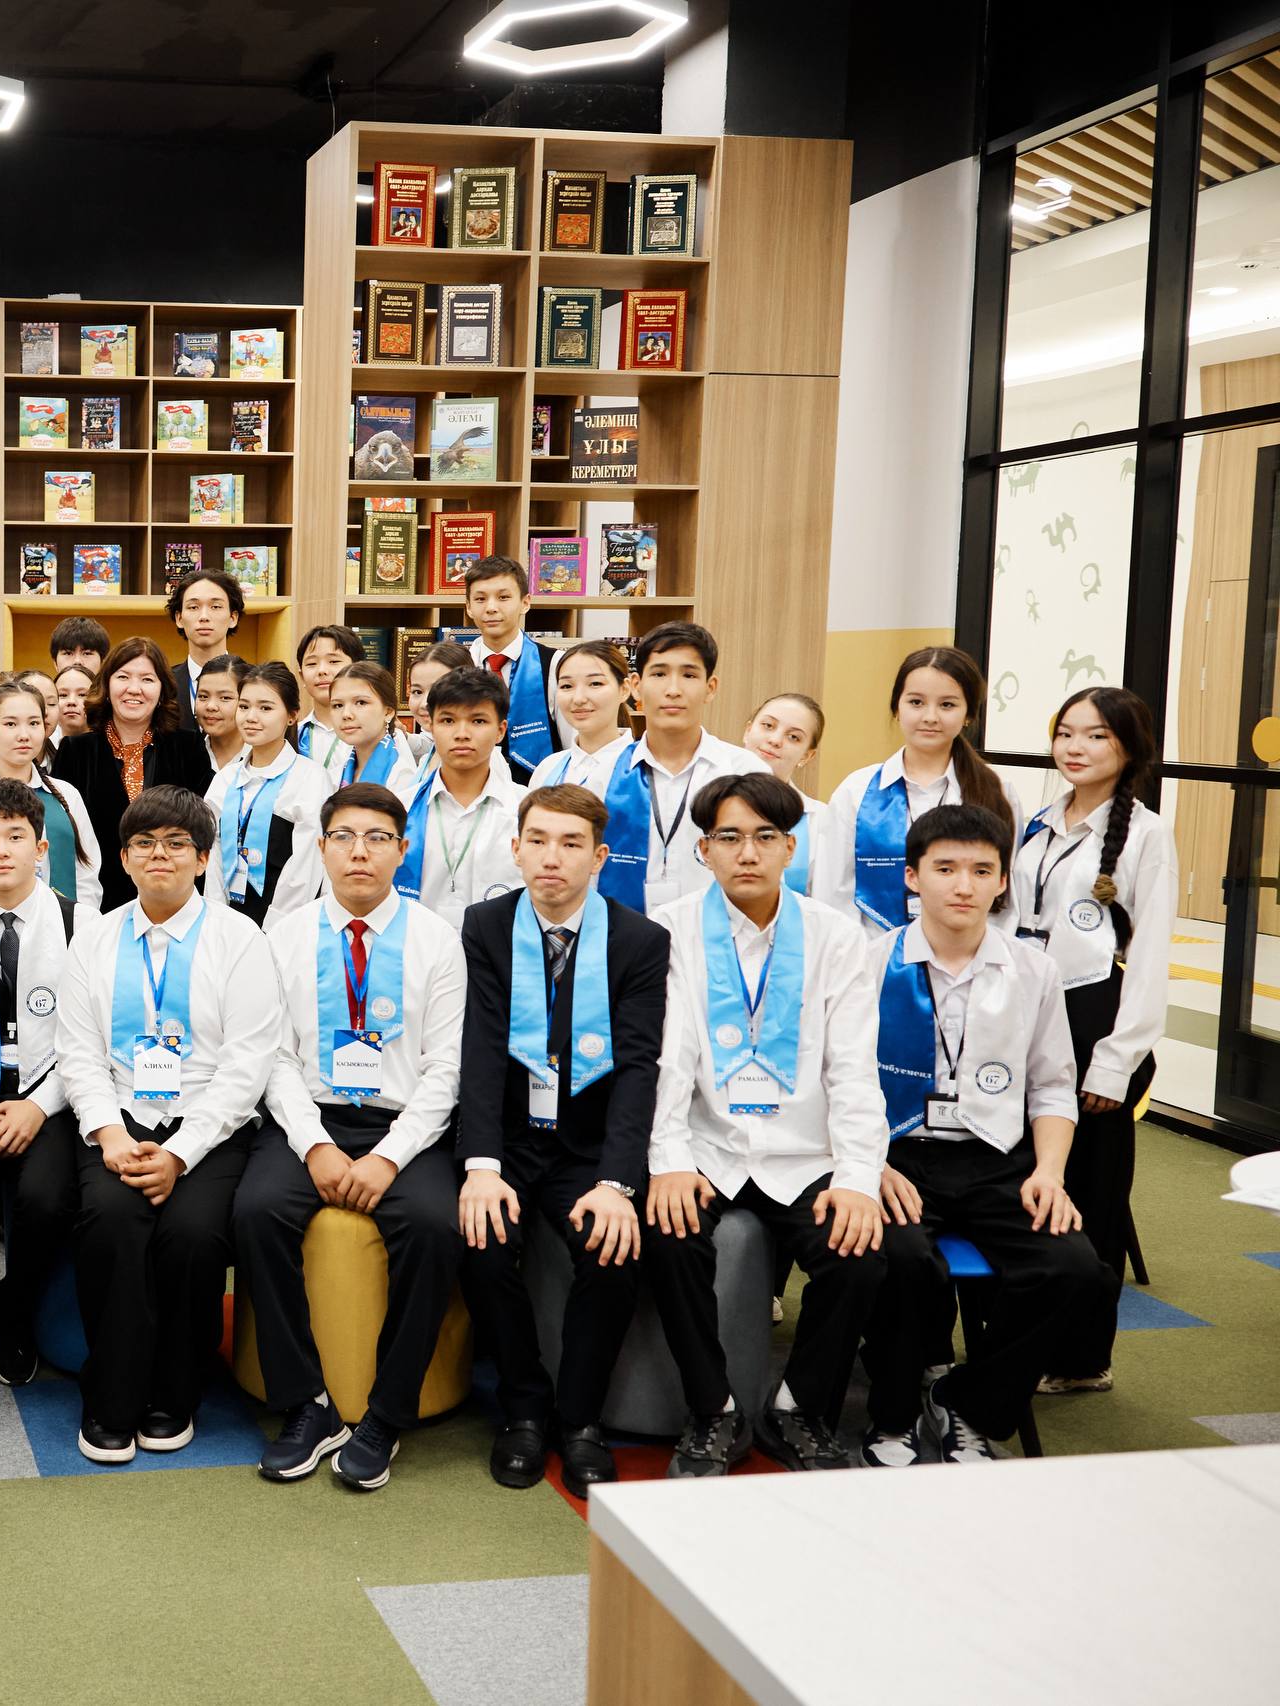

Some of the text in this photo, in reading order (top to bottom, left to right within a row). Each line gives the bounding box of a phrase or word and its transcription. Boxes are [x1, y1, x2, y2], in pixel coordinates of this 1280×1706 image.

[448, 414, 483, 423] ӘЛЕМІ
[584, 413, 638, 430] ӘЛЕМНІҢ
[583, 438, 629, 456] ҰЛЫ
[571, 464, 638, 479] КЕРЕМЕТТЕРІ
[35, 998, 47, 1008] 67
[985, 1074, 1000, 1085] 67
